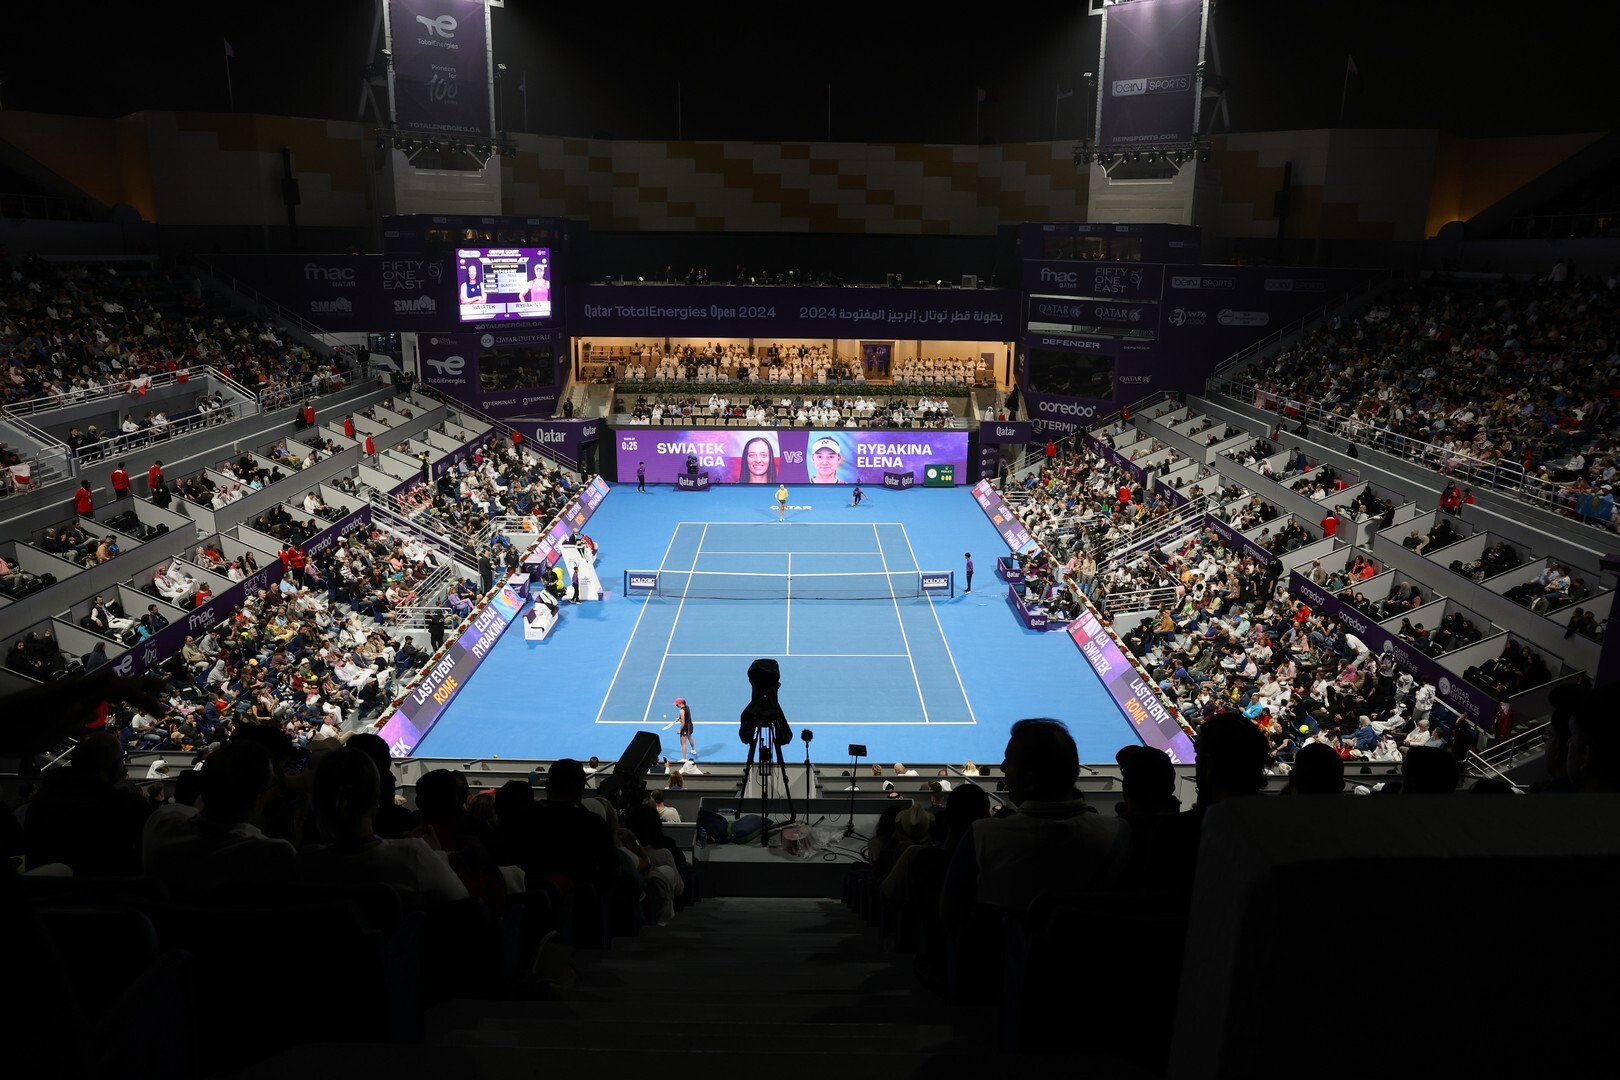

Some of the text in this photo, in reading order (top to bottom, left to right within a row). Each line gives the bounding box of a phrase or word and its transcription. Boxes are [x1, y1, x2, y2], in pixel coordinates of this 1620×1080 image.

[418, 38, 458, 50] TotalEnergies
[432, 64, 456, 72] Pioneers
[1150, 78, 1186, 90] SPORTS
[1112, 133, 1178, 142] BEINSPORTS.COM
[382, 260, 424, 270] FIFTY
[304, 264, 356, 280] fnac
[383, 270, 416, 280] ONE
[1040, 267, 1078, 282] fnac
[1095, 267, 1128, 276] FIFTY
[332, 280, 356, 288] QATAR
[383, 280, 424, 290] EAST
[1094, 276, 1120, 284] ONE
[1202, 280, 1233, 288] SPORTS
[1094, 284, 1127, 293] EAST
[584, 304, 776, 320] Qatar TotalEnergies Open 2024
[800, 306, 838, 318] 2024
[838, 308, 885, 322] المفتوحة
[1038, 304, 1069, 314] QATAR
[1094, 307, 1128, 318] QATAR
[918, 310, 948, 324] توتال
[950, 310, 971, 324] قطر
[973, 312, 1004, 324] بطولة
[496, 336, 516, 344] QATAR
[1042, 338, 1100, 349] DEFENDER
[482, 395, 555, 410] QTERMINALS QTERMINALS
[1039, 401, 1096, 418] ooredoo
[536, 428, 566, 444] Qatar
[582, 426, 596, 437] Qatar
[996, 426, 1016, 437] Qatar
[622, 442, 638, 450] 0:25
[656, 442, 725, 454] SWIATEK
[857, 444, 932, 456] RYBAKINA
[700, 456, 725, 468] IGA
[784, 451, 804, 464] VS
[857, 456, 904, 468] ELENA
[679, 476, 708, 486] Qatar Qatar
[884, 476, 914, 486] Qatar Qatar
[1210, 522, 1232, 541] QTERMINALS
[308, 534, 332, 557] ooredoo
[1243, 544, 1268, 566] QTERMINALS
[1006, 570, 1020, 578] Qatar
[244, 576, 261, 590] FIFTY
[1300, 584, 1326, 606] ooredoo
[188, 608, 214, 630] fnac
[474, 606, 498, 633] ELENA
[1030, 618, 1046, 626] Qatar
[1338, 610, 1368, 634] ooredoo
[472, 616, 506, 659] RYBAKINA
[1094, 630, 1110, 650] IGA
[1082, 640, 1112, 677] SWIATEK
[412, 654, 456, 706] LAST EVENT
[432, 675, 458, 706] ROME
[1451, 684, 1470, 700] QATAR
[1129, 677, 1170, 724] LAST EVENT
[1450, 691, 1480, 716] DUTY FREE
[1124, 697, 1149, 726] ROME
